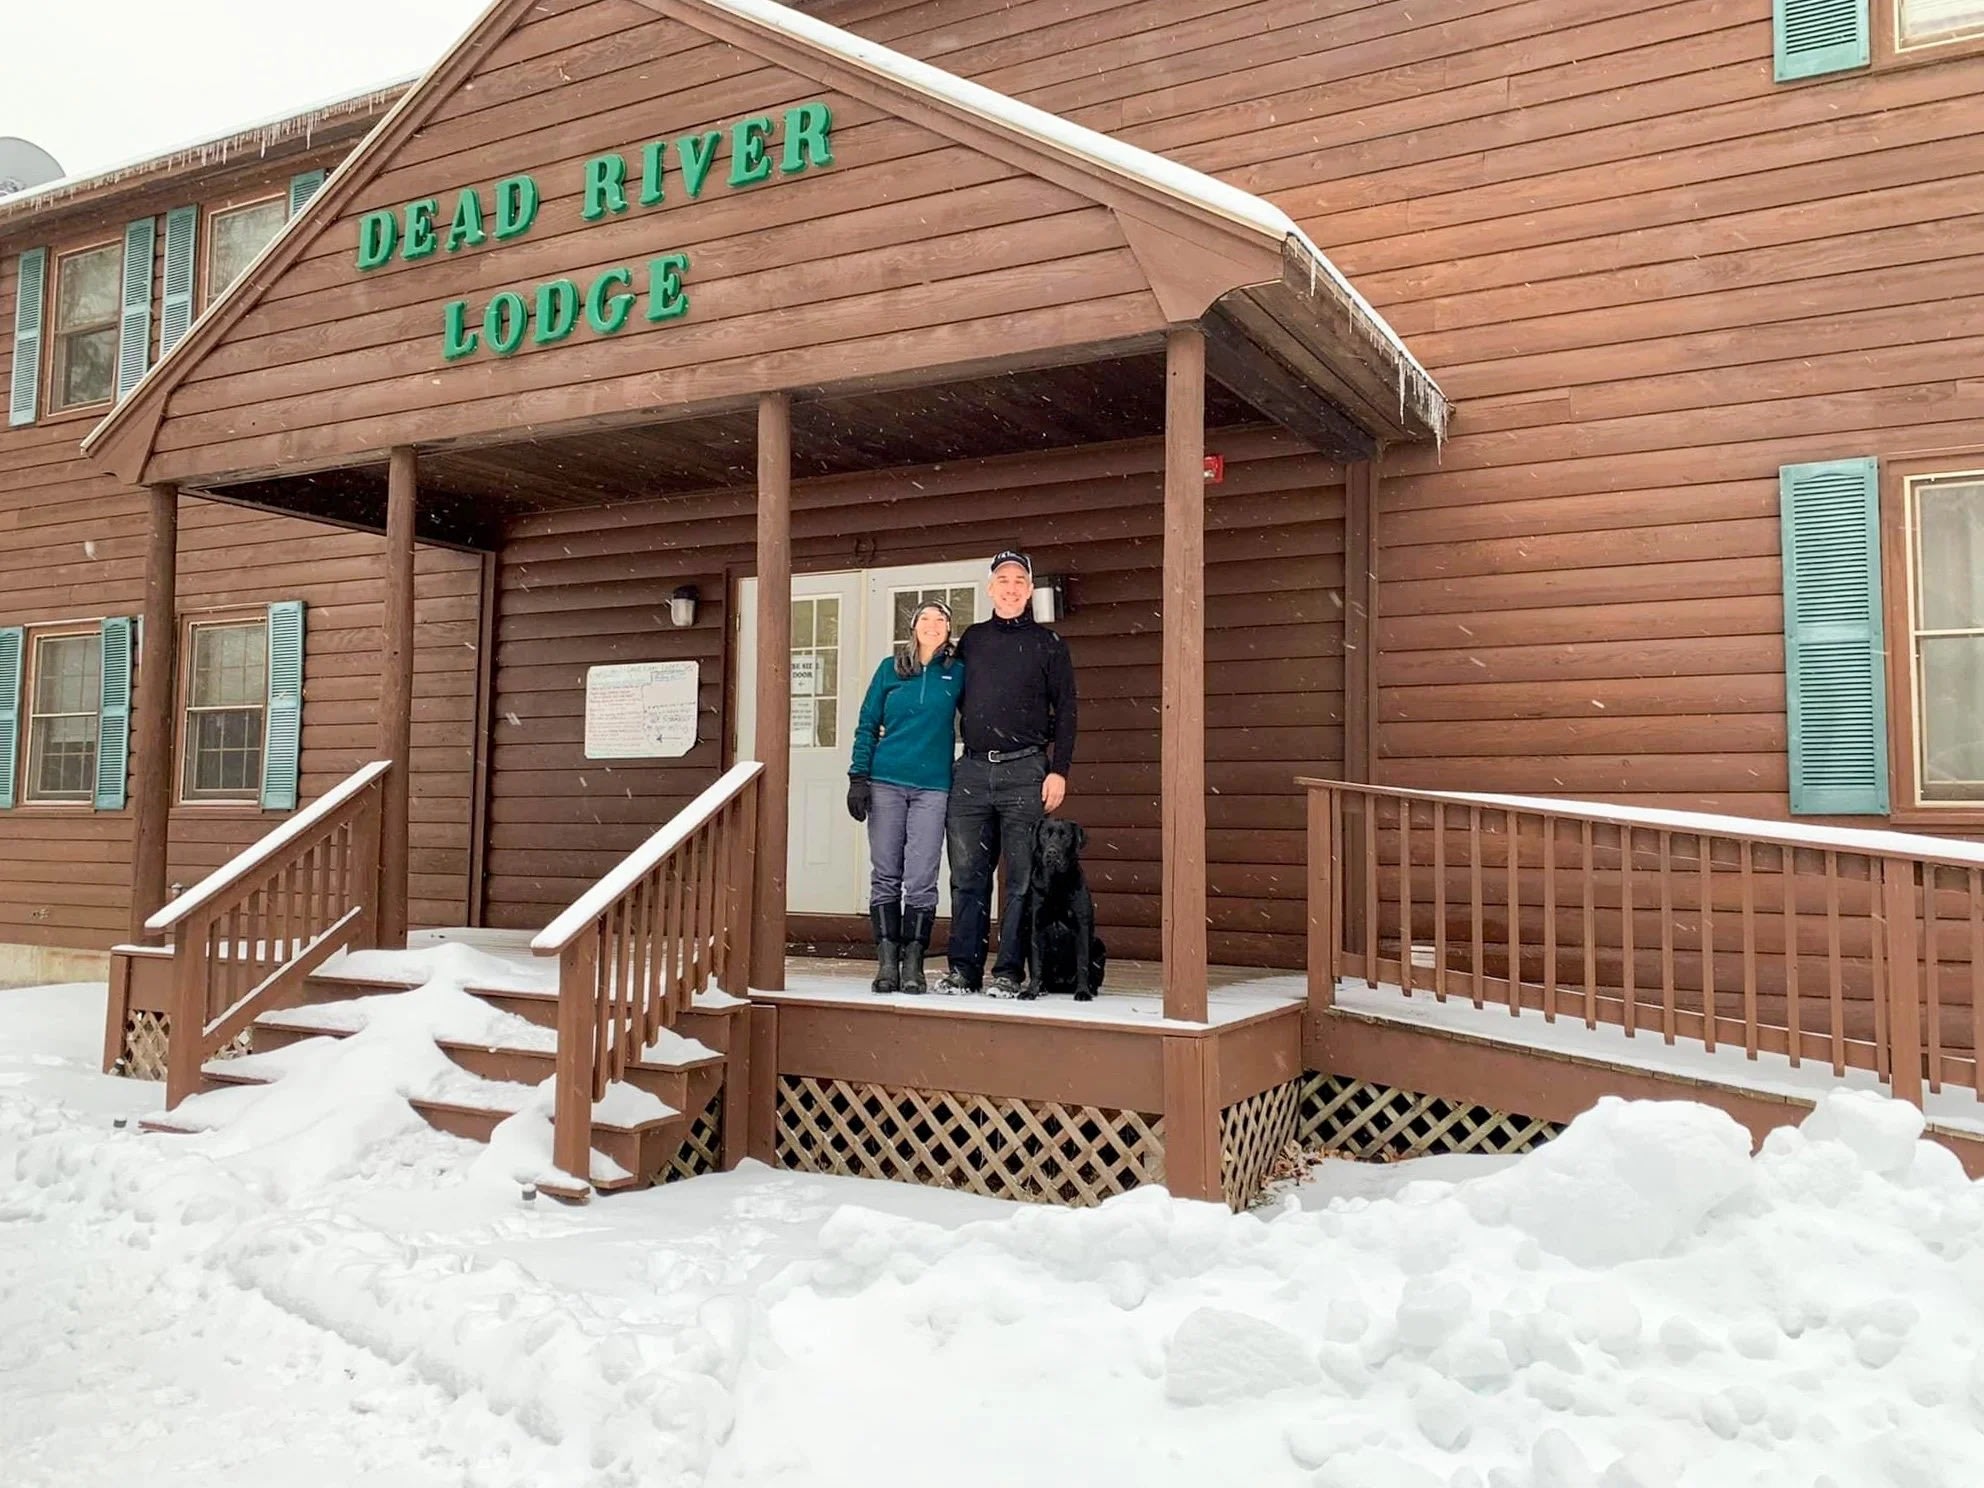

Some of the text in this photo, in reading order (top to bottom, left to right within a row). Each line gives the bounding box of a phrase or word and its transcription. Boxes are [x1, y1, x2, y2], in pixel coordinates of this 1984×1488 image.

[357, 102, 832, 271] DEAD RIVER
[443, 254, 690, 360] LODGE
